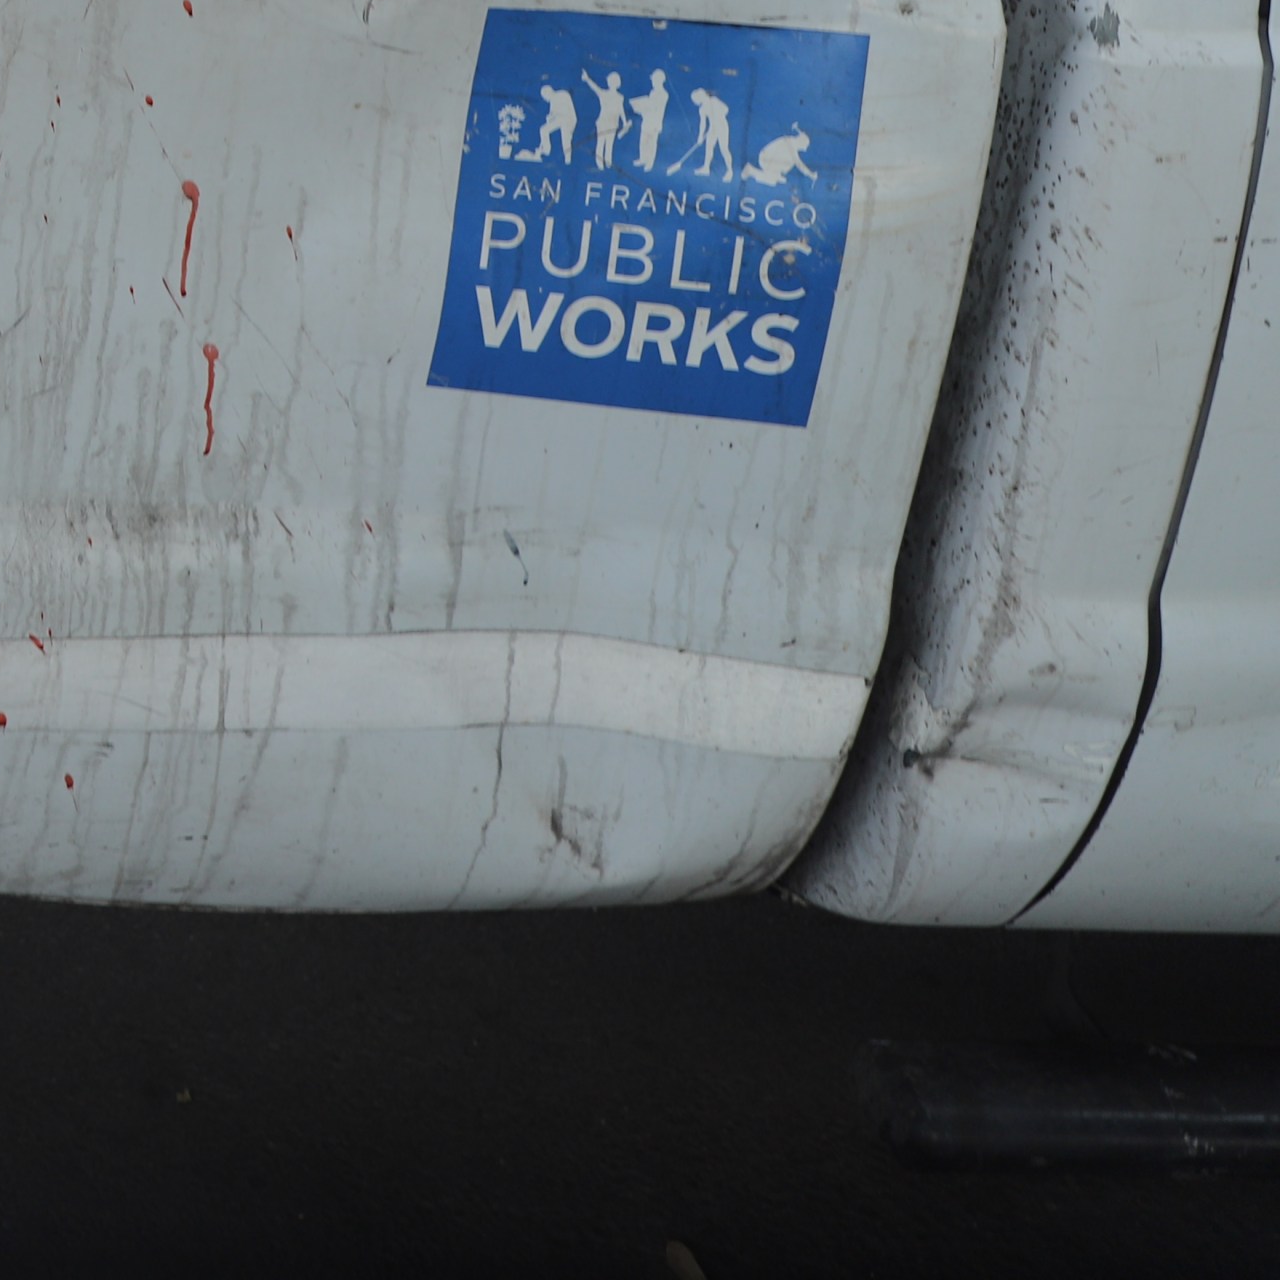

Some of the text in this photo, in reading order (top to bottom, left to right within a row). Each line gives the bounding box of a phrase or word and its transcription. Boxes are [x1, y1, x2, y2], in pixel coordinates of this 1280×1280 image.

[489, 173, 818, 229] SAN FRANCISCO
[479, 210, 813, 301] PUBLIC
[475, 285, 801, 375] WORKS
